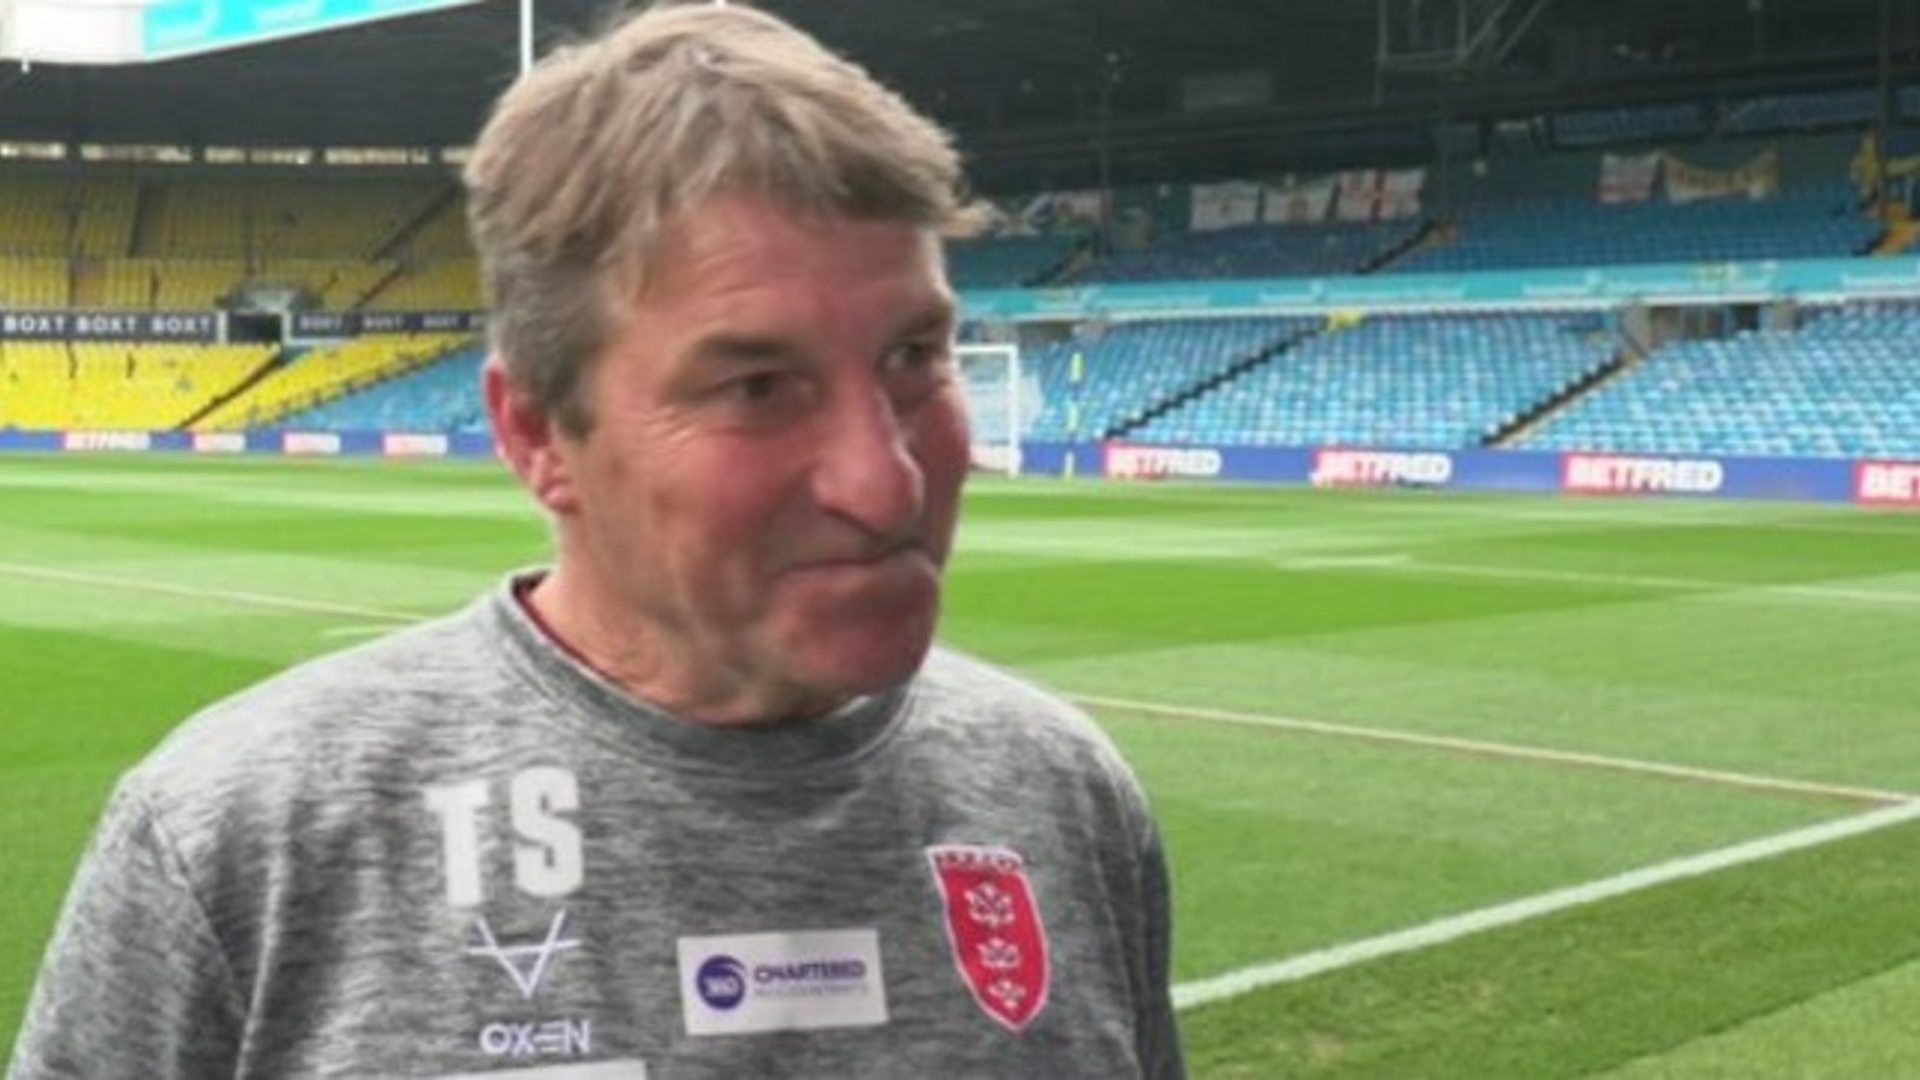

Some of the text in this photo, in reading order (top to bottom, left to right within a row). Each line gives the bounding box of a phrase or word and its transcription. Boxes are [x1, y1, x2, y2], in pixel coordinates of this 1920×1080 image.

[3, 315, 211, 333] BOXT BOXT BOXT
[1105, 444, 1222, 477] BETFRED
[1318, 449, 1452, 484] BETFRED
[1565, 455, 1724, 491] BETFRED
[754, 959, 867, 984] CHARTERED
[480, 1019, 590, 1058] OXEN
